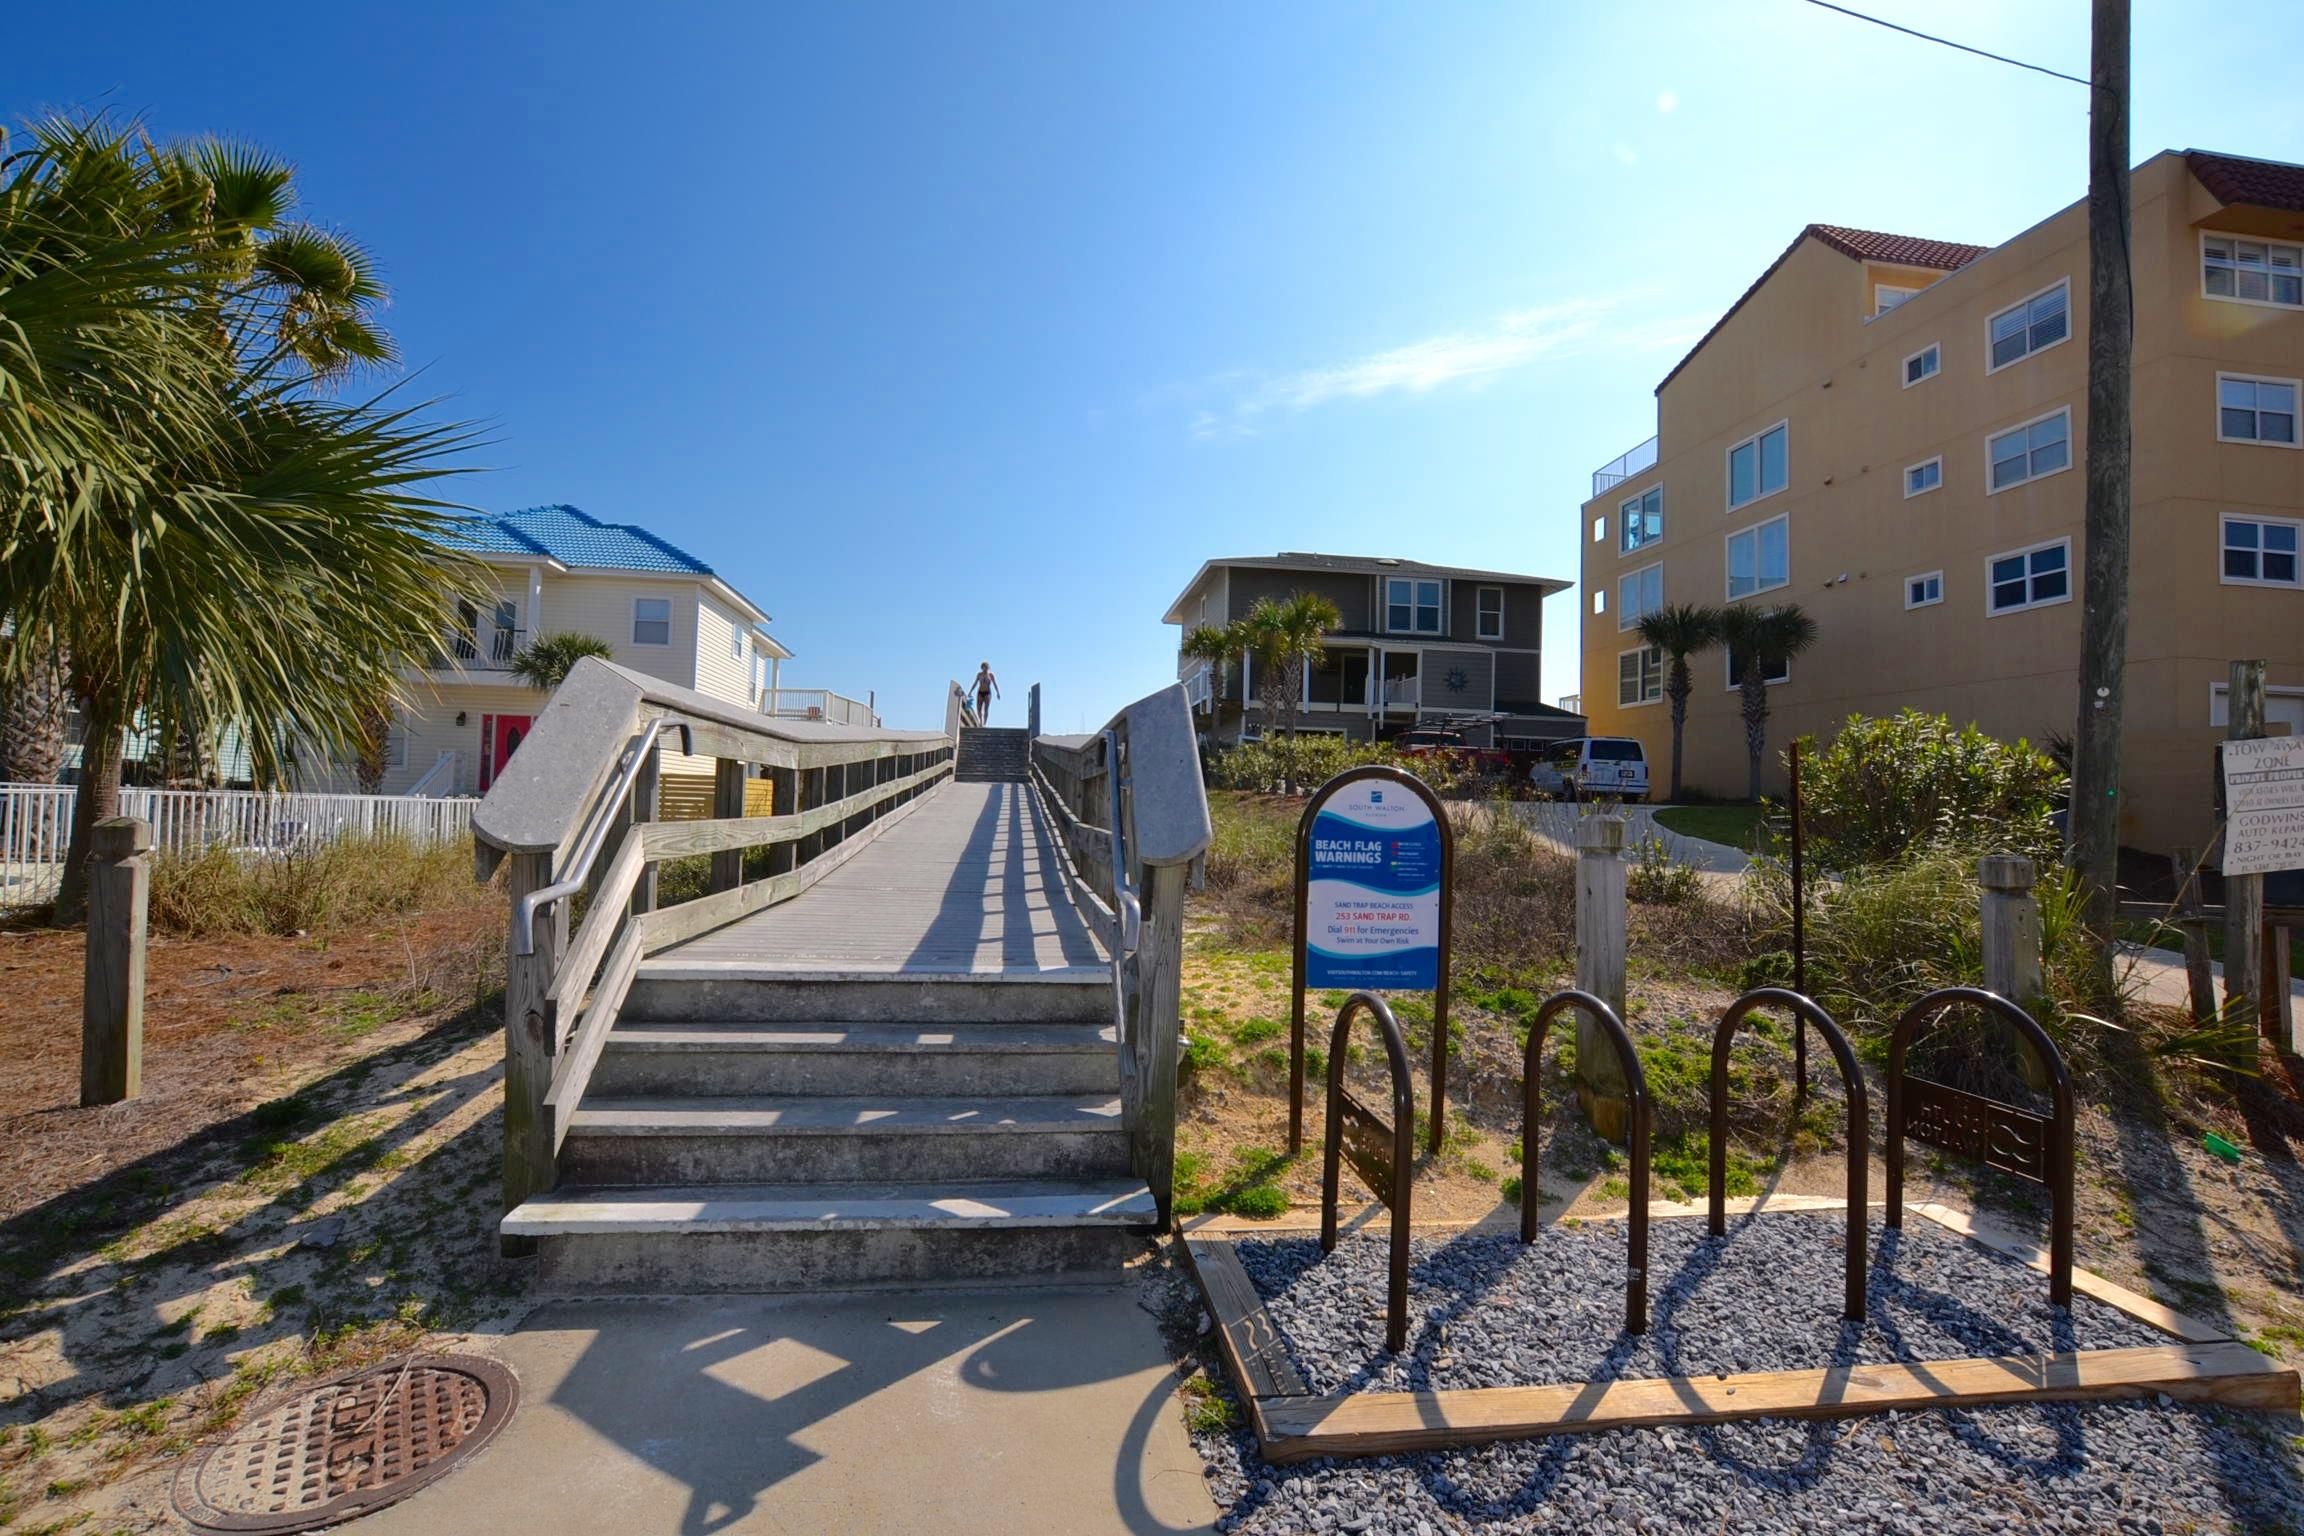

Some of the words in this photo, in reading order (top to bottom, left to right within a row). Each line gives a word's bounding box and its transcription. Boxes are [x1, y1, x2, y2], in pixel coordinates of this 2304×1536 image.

[2234, 743, 2265, 756] TOW
[2254, 756, 2291, 769] ZONE
[2230, 773, 2265, 784] PRIVATE
[2268, 770, 2304, 781] PROPER
[1349, 804, 1372, 812] SOUTH
[2239, 827, 2267, 838] AUTO
[1315, 839, 1351, 851] BEACH
[1355, 840, 1382, 852] FLAG
[1315, 851, 1382, 864] WARNINGS
[2237, 854, 2265, 864] NIGHT
[1334, 901, 1351, 909] SAND
[1352, 901, 1368, 909] TRAP
[1391, 902, 1414, 910] ACCESS
[1336, 912, 1351, 920] 253
[1353, 912, 1374, 921] SAND
[1377, 913, 1397, 921] TRAP
[1328, 925, 1342, 934] Dial
[1344, 926, 1356, 934] 911
[1357, 926, 1368, 934] for
[1370, 926, 1419, 936] Emergencies
[1336, 936, 1354, 944] Swim
[1396, 937, 1409, 945] Risk
